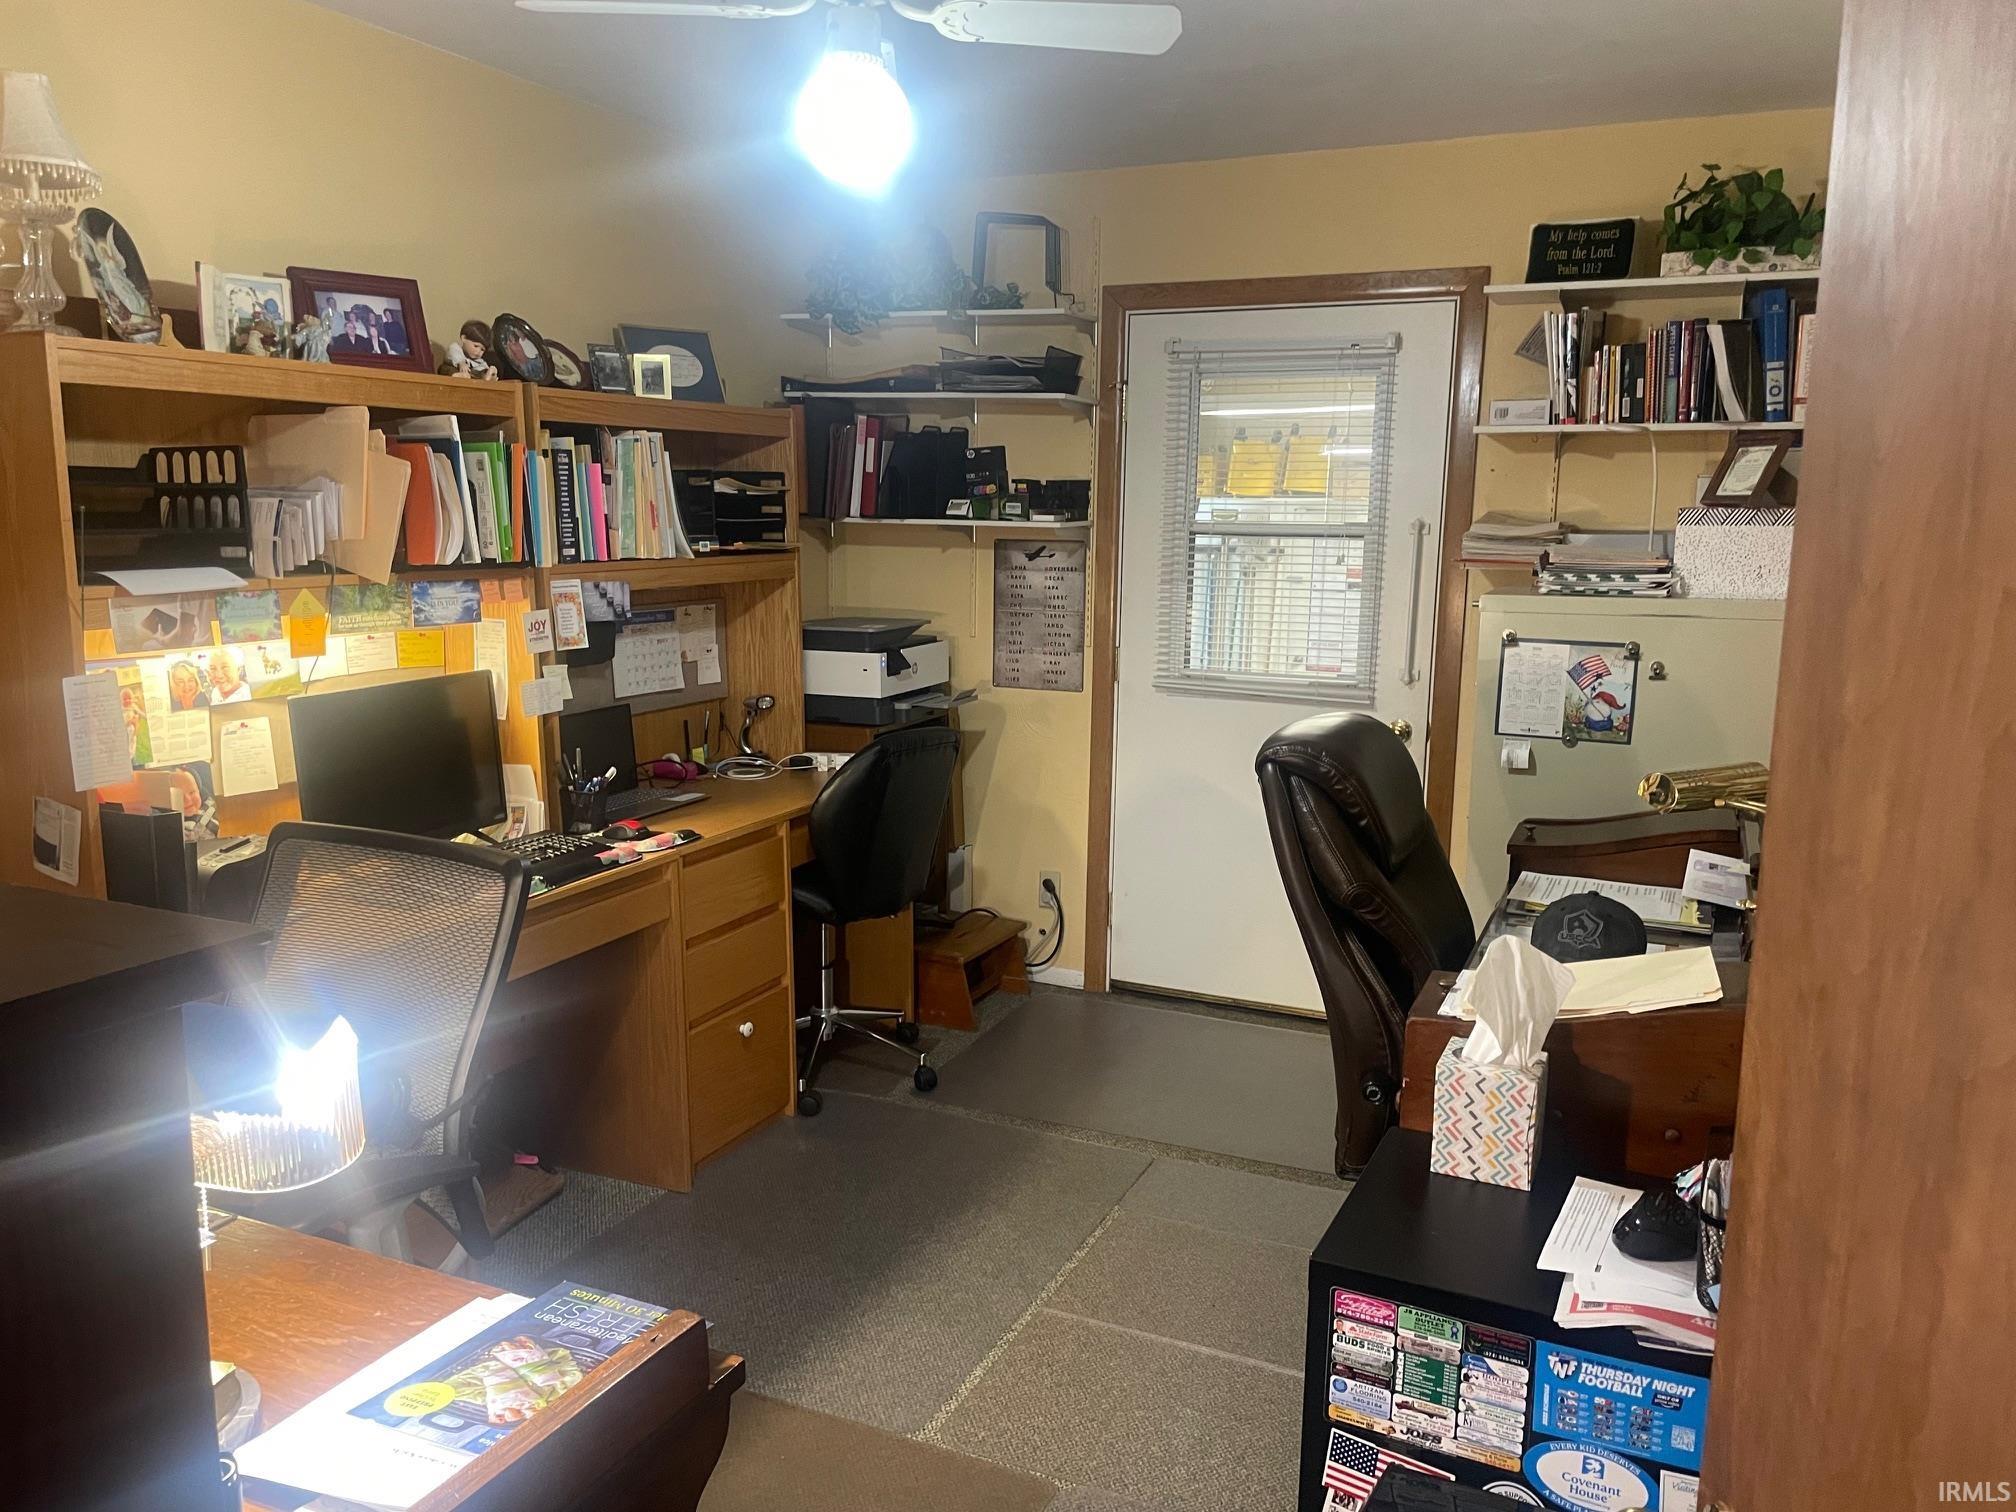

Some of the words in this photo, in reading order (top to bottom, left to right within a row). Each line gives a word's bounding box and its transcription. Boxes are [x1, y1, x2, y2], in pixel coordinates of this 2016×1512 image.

[1548, 229, 1564, 244] My
[1567, 228, 1588, 244] help
[1591, 228, 1620, 240] comes
[1546, 246, 1568, 262] from
[1571, 245, 1588, 260] the
[1590, 243, 1617, 259] Lord.
[528, 620, 547, 633] JOY
[570, 1288, 624, 1311] Minutes
[625, 1304, 648, 1316] 30
[1336, 1334, 1365, 1349] BUDS
[1578, 1373, 1643, 1398] FOOTBALL
[1580, 1361, 1651, 1388] THURSDAY
[1652, 1379, 1696, 1398] NIGHT
[1550, 1442, 1578, 1451] EVERY
[1579, 1444, 1596, 1453] KID
[1600, 1448, 1642, 1475] DESERVES
[1562, 1471, 1622, 1498] Covenant
[1569, 1484, 1608, 1504] House
[1550, 1494, 1572, 1509] SAFE
